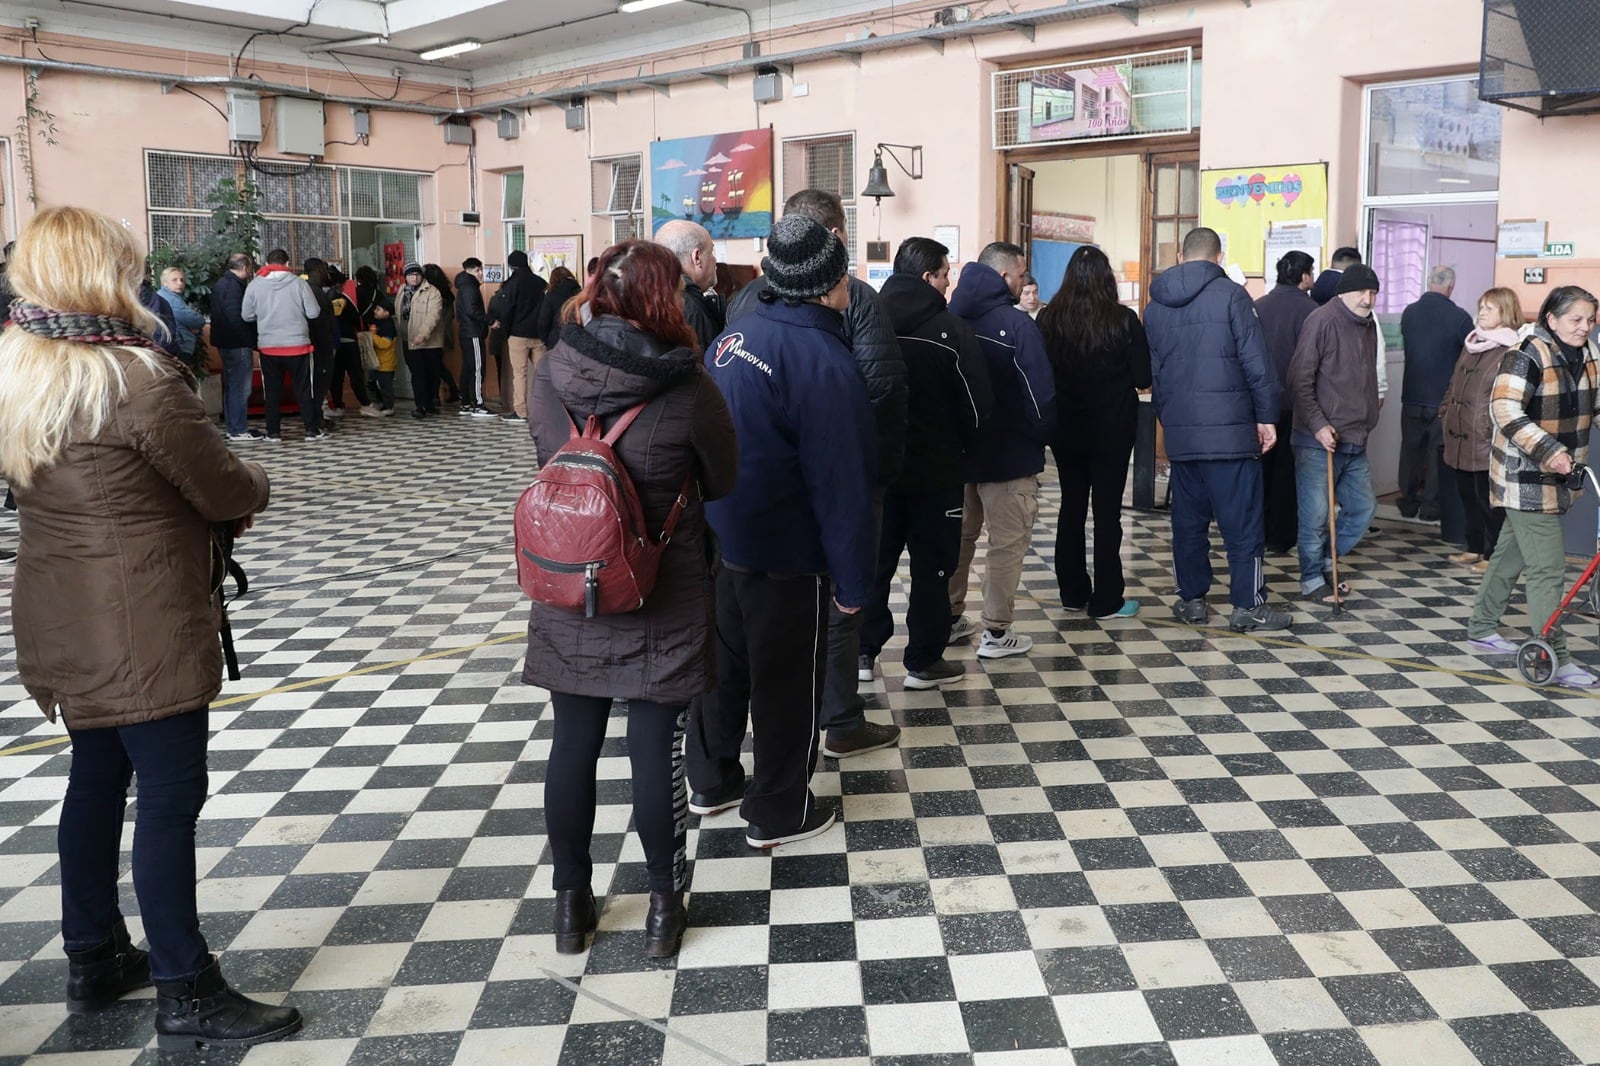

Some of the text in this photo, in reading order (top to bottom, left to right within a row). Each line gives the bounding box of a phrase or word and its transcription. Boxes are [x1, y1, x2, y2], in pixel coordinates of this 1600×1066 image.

[1088, 117, 1128, 129] 100 Años
[1215, 181, 1303, 200] BIENVENIDOS
[486, 271, 501, 280] 499
